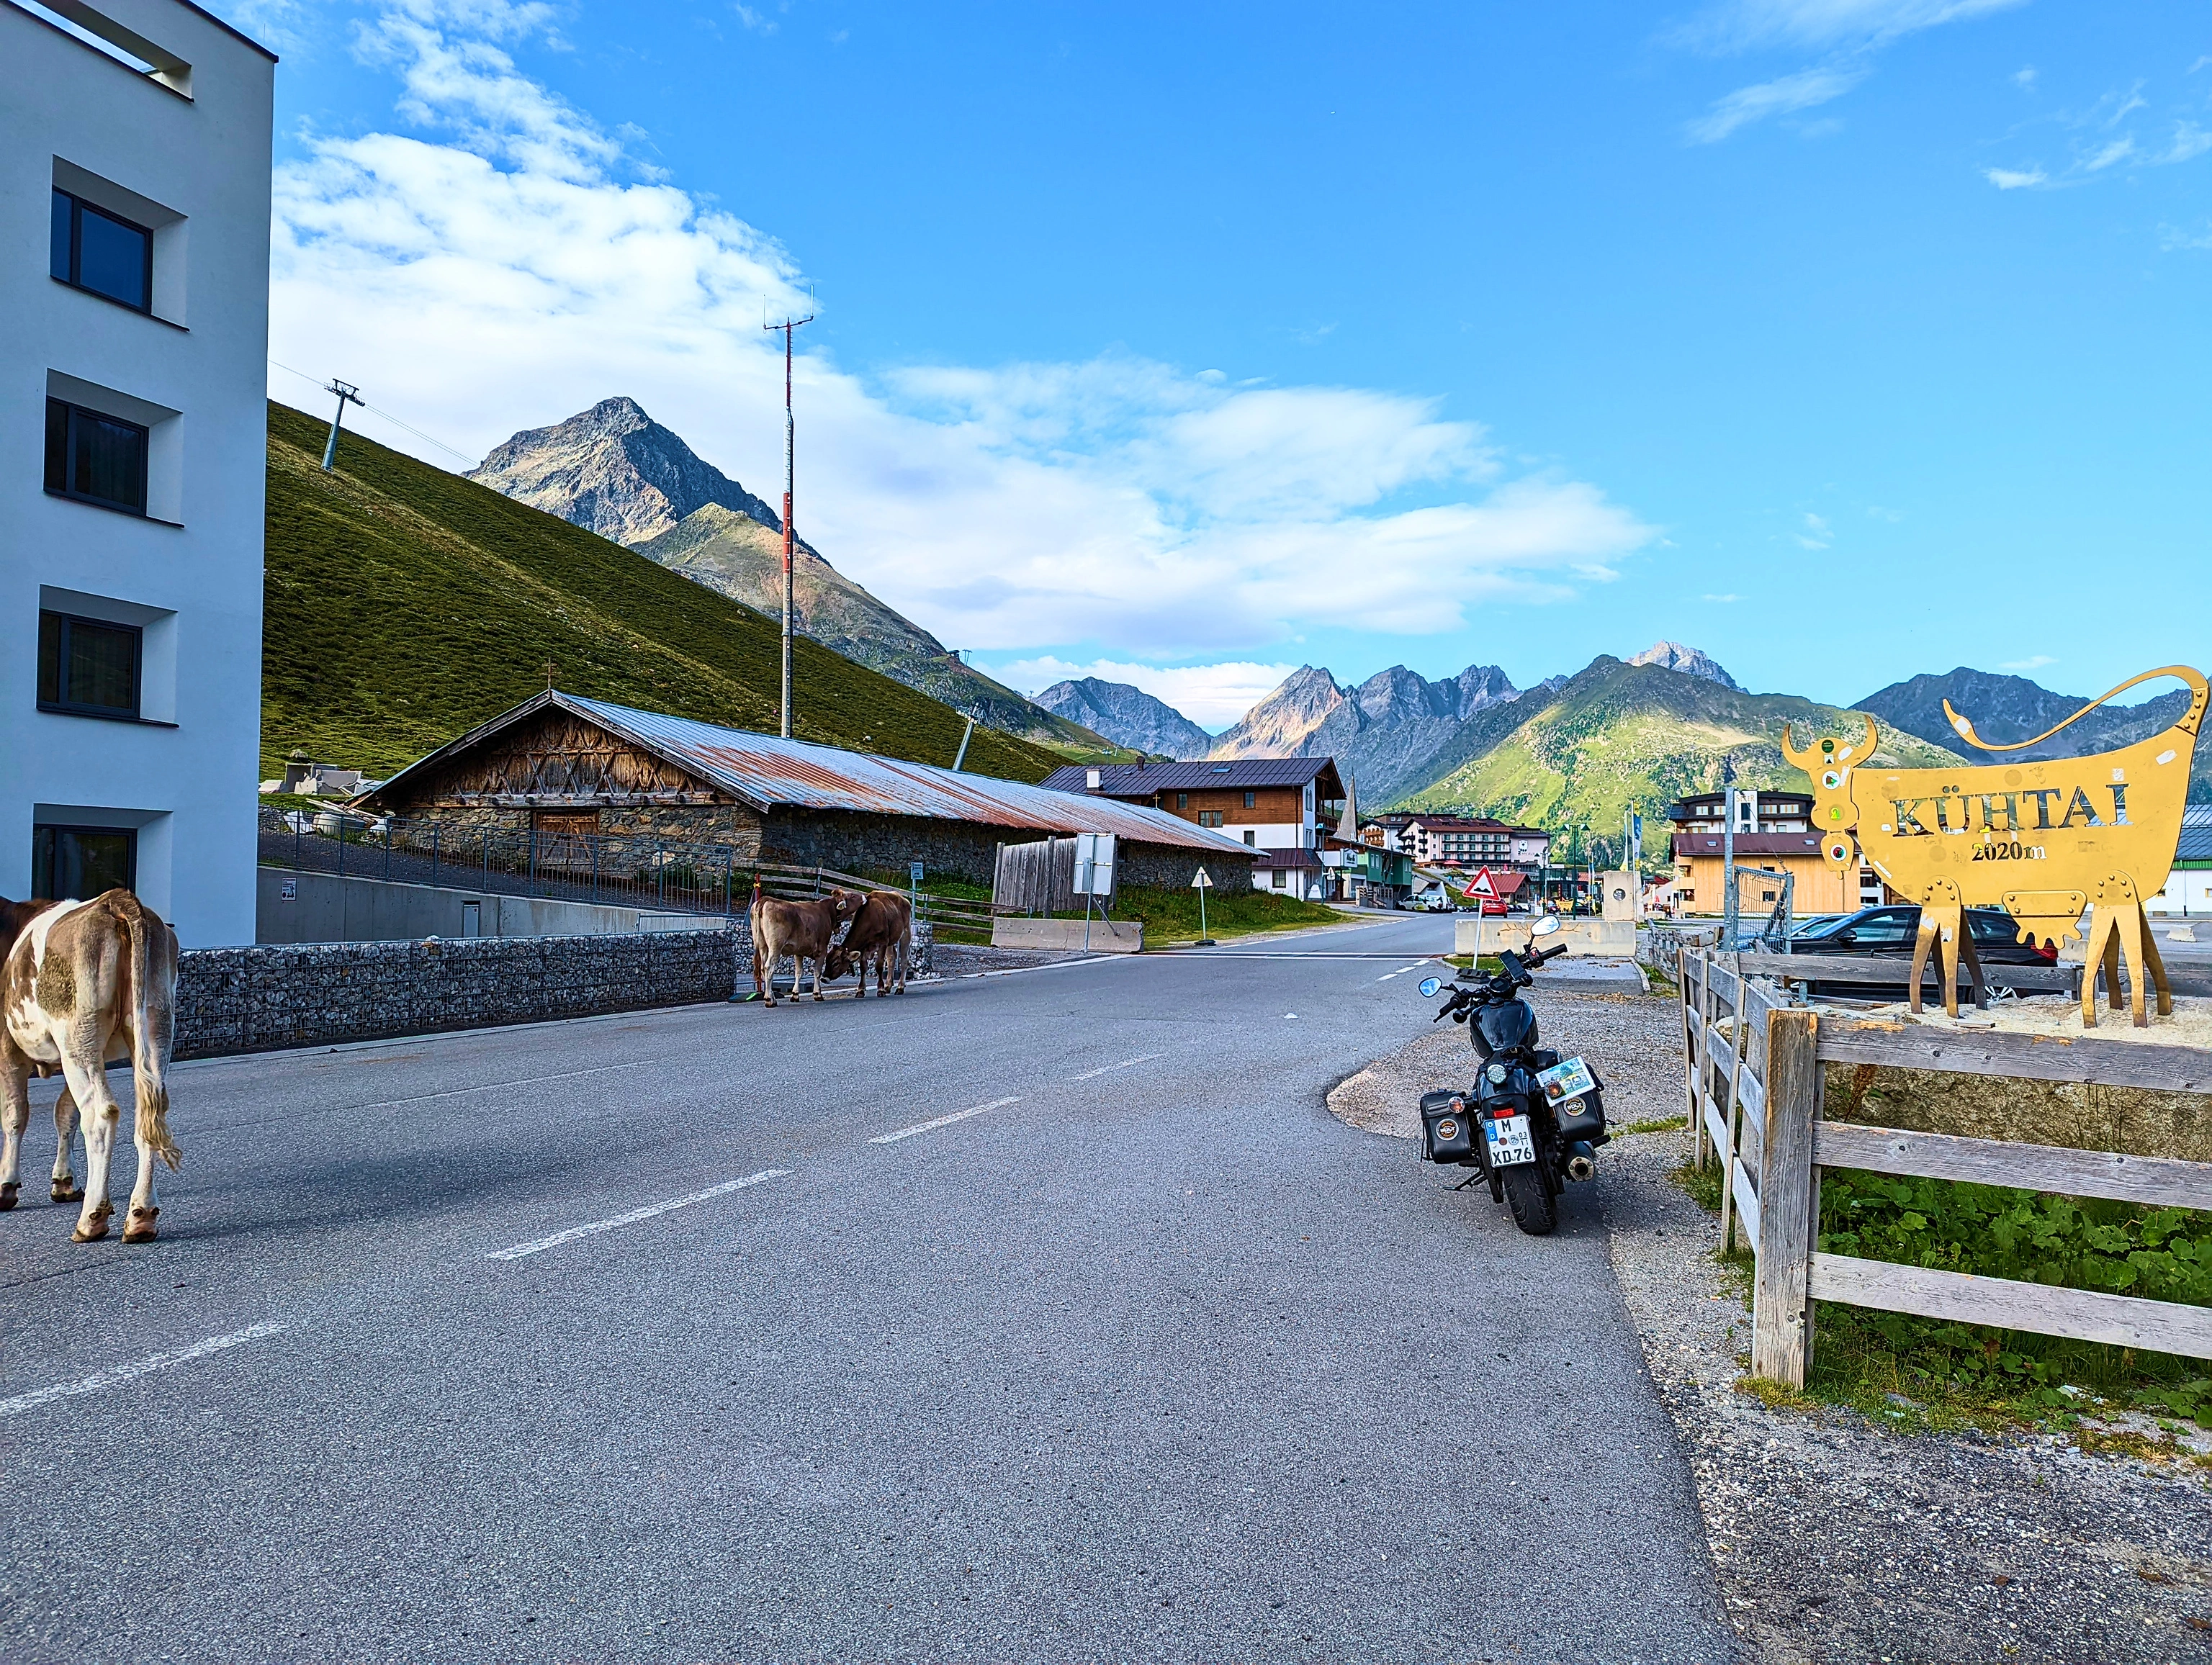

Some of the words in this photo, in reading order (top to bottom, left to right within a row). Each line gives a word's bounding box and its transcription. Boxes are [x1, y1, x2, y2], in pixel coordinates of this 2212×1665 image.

[1889, 782, 2134, 837] KÜHTAI
[1972, 841, 2047, 862] 2020m
[1501, 1119, 1511, 1132] M
